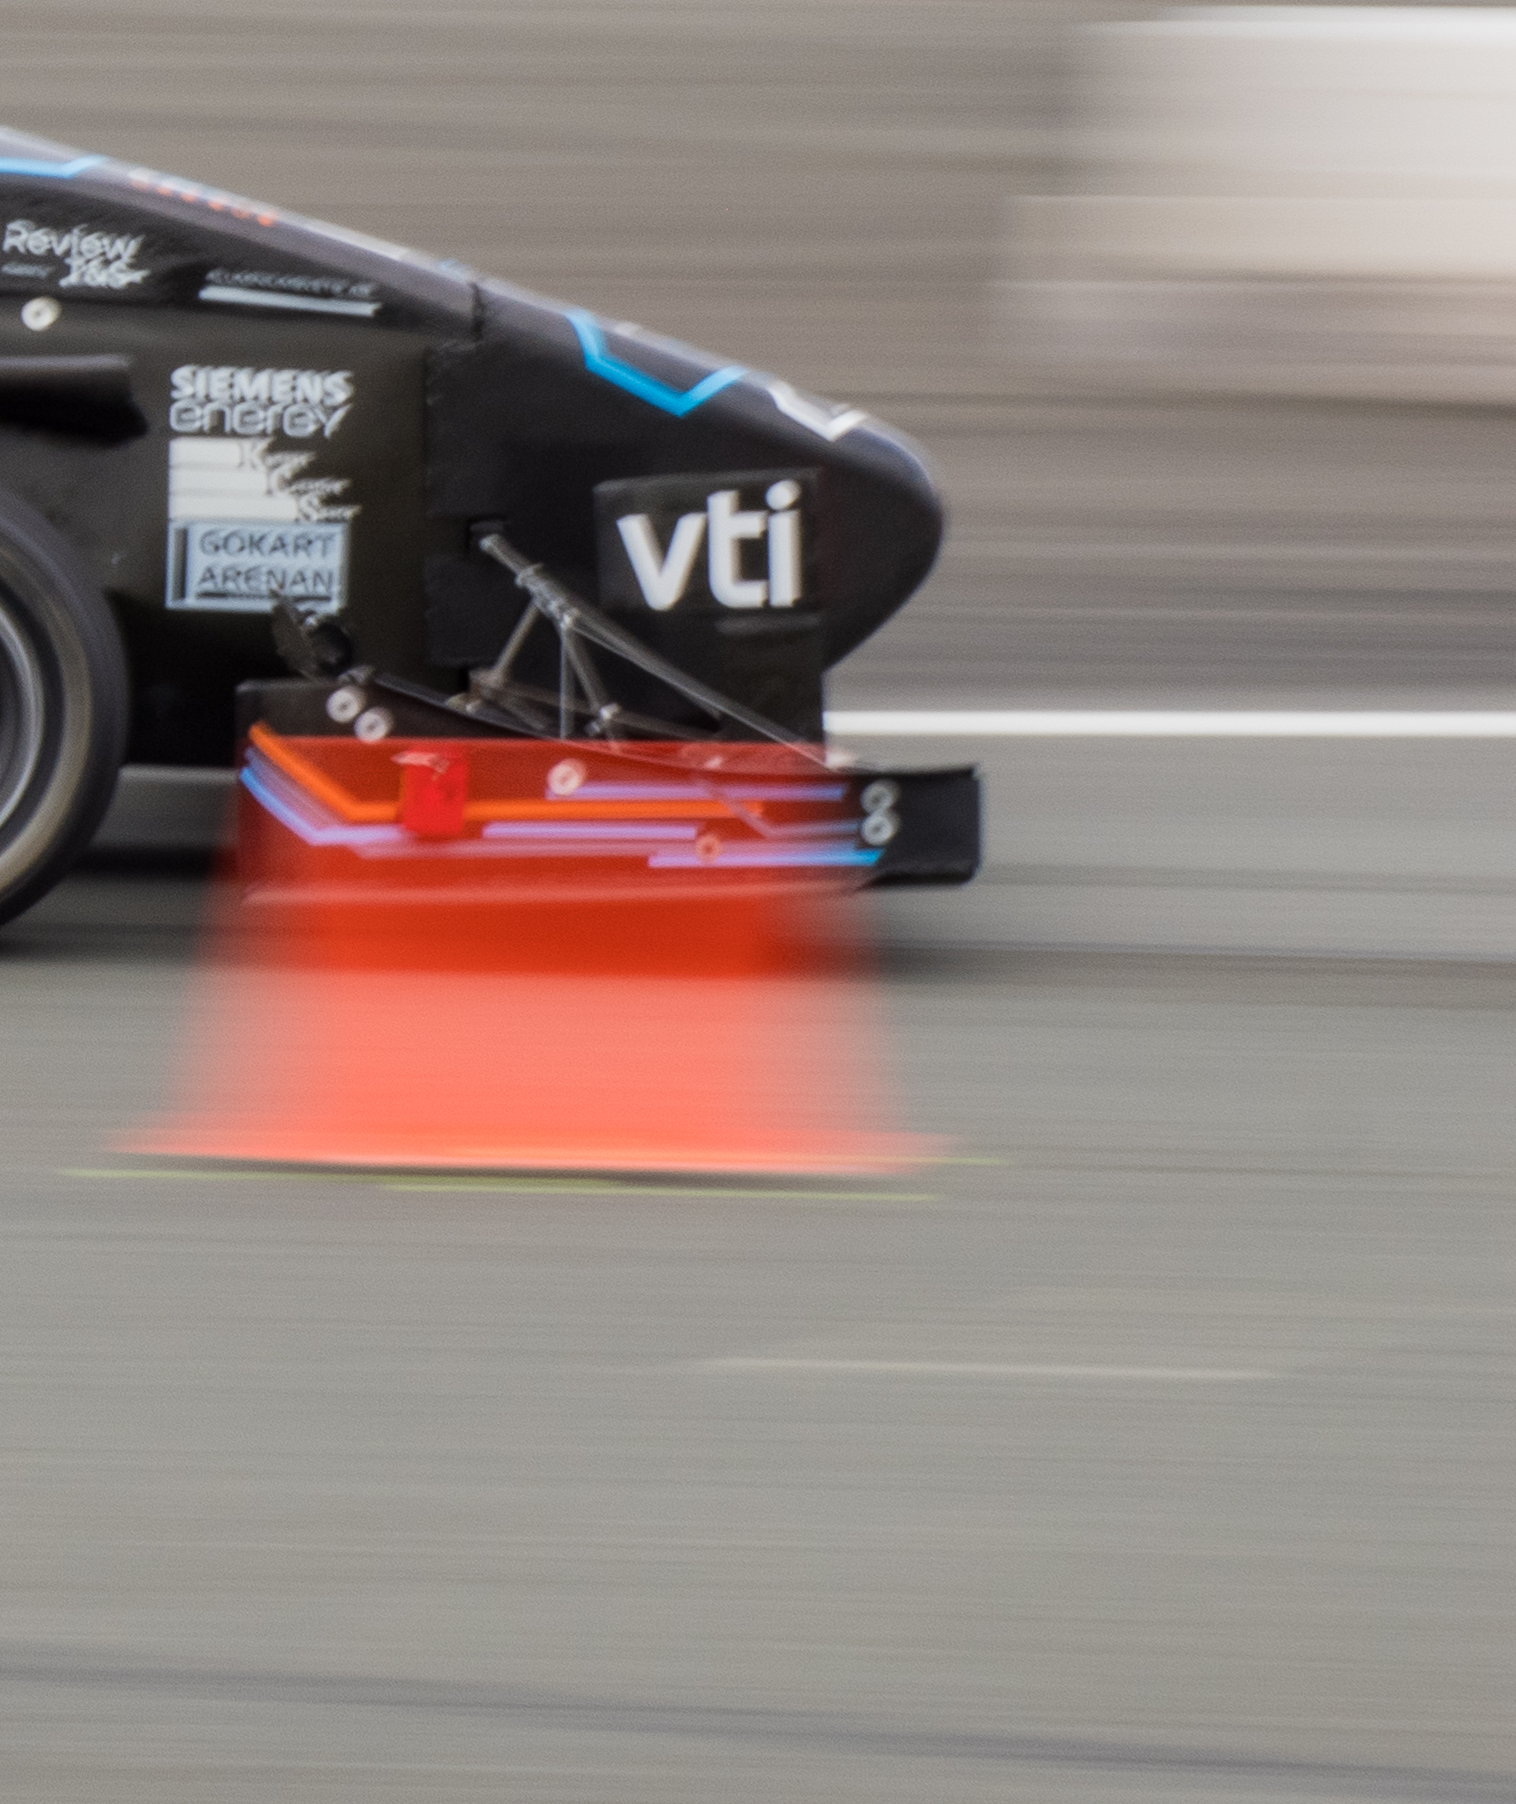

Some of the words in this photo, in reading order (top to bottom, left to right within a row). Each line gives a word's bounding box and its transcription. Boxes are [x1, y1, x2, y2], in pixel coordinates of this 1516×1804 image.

[3, 220, 144, 260] Review
[171, 365, 353, 405] SIEMENS
[169, 400, 353, 439] energy
[199, 528, 336, 559] GOKART
[617, 479, 802, 611] vti
[197, 564, 333, 592] ARENAN
